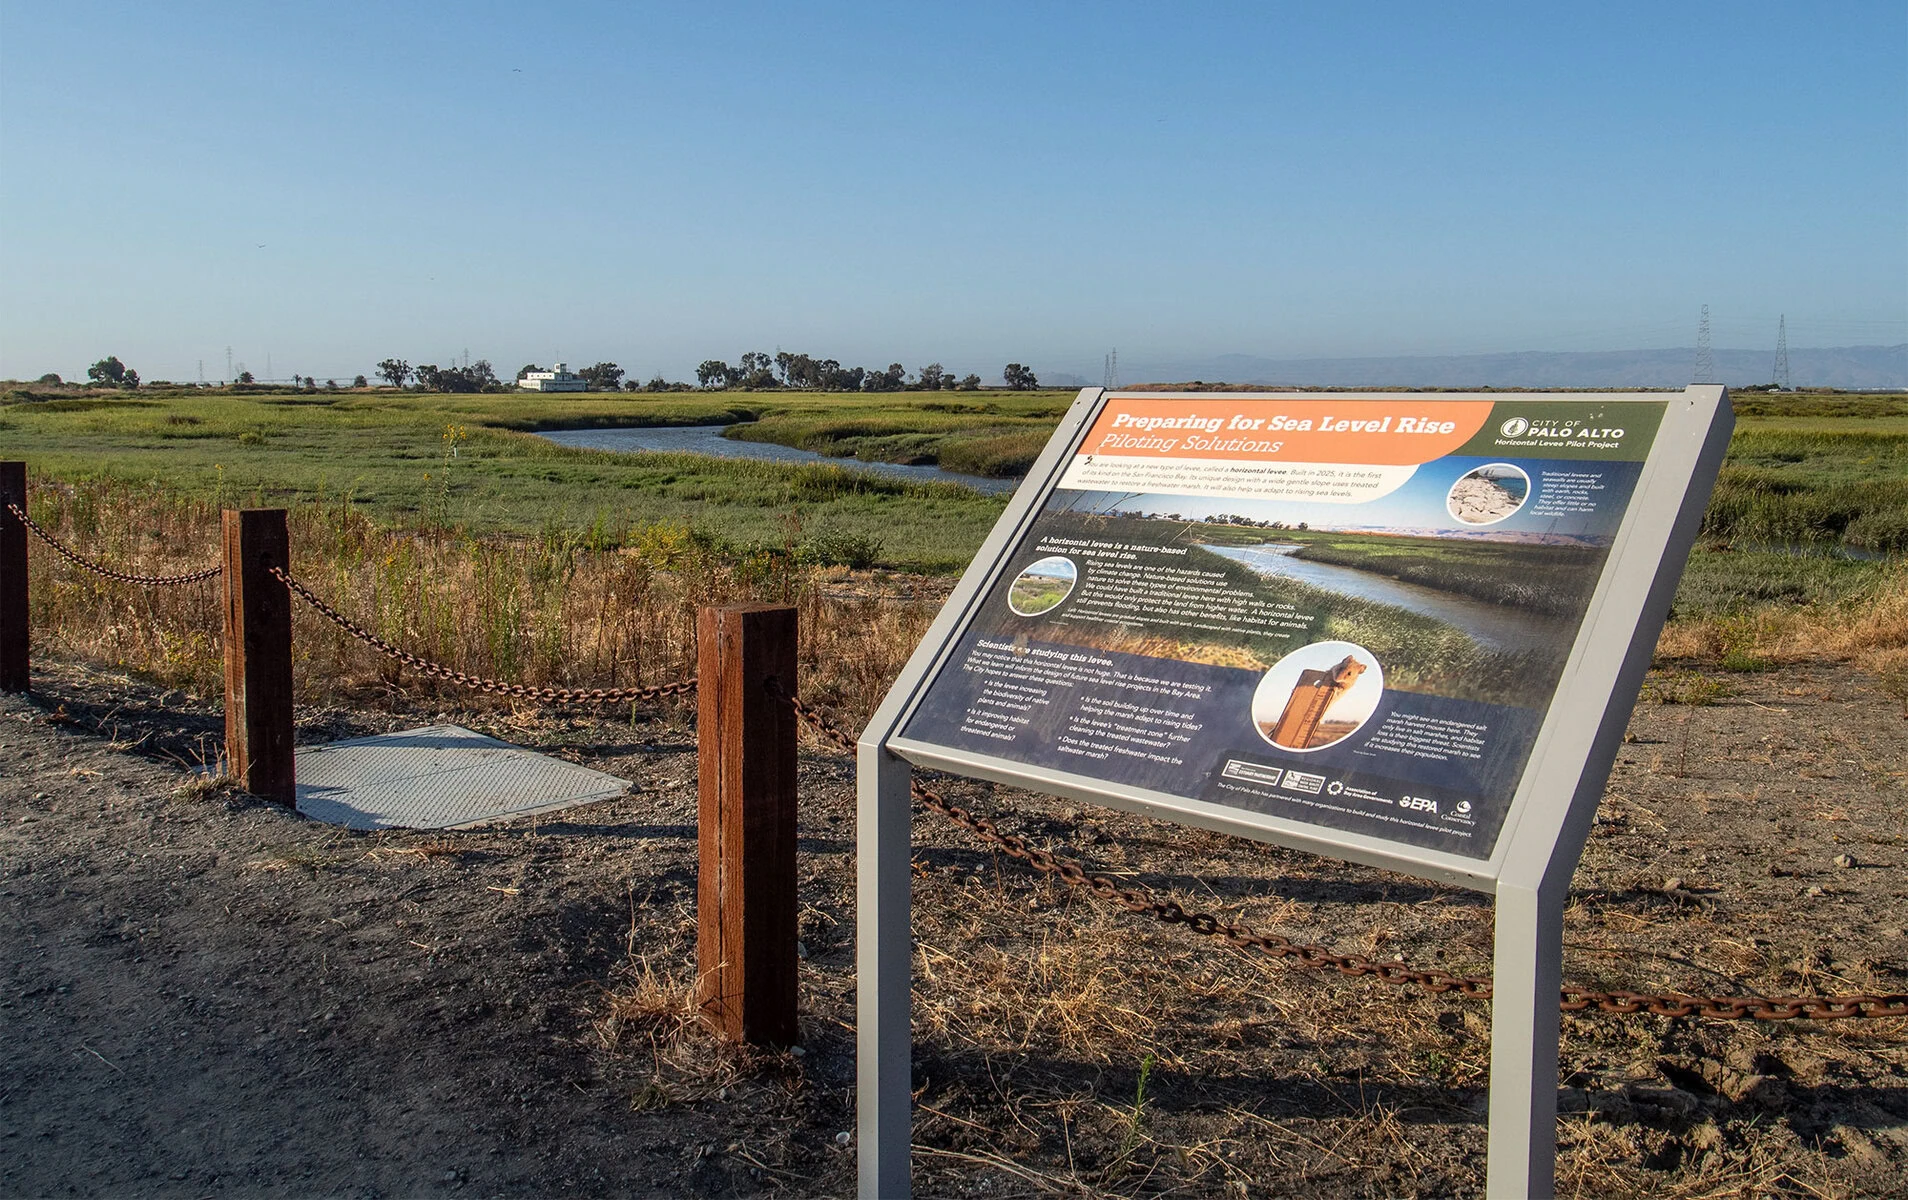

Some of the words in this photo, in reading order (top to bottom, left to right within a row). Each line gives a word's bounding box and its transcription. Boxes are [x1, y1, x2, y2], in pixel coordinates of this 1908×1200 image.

[1111, 413, 1222, 432] Preparing
[1225, 414, 1265, 429] for
[1268, 415, 1312, 430] Sea
[1317, 416, 1393, 432] Level
[1393, 417, 1453, 433] Rise
[1527, 427, 1571, 436] PALO
[1577, 428, 1623, 437] ALTO
[1100, 433, 1177, 453] Piloting
[1181, 435, 1282, 452] Solutions
[1587, 441, 1619, 449] Project
[1035, 545, 1068, 553] solution
[1096, 549, 1119, 557] level
[1048, 537, 1091, 546] horizontal
[1089, 540, 1113, 548] levee
[1129, 545, 1187, 554] nature-based
[1085, 559, 1103, 567] Rising
[1118, 570, 1141, 578] change.
[1142, 572, 1186, 582] Nature-based
[1185, 577, 1214, 585] solutions
[1148, 589, 1182, 597] traditional
[1231, 597, 1247, 606] high
[1113, 601, 1140, 611] flooding,
[1199, 611, 1227, 620] benefits,
[1241, 616, 1267, 624] habitat
[1279, 621, 1307, 629] animals.
[1204, 603, 1227, 611] higher
[1258, 609, 1295, 618] horizontal
[977, 639, 1016, 651] Scientists
[1031, 648, 1068, 661] studying
[1068, 653, 1086, 661] this
[1086, 655, 1113, 666] levee.
[1113, 701, 1138, 712] building
[1079, 704, 1103, 715] helping
[1134, 715, 1154, 723] adapt
[1162, 719, 1180, 728] rising
[1180, 722, 1202, 730] tides?
[1439, 719, 1476, 728] endangered
[1068, 724, 1094, 736] cleaning
[1105, 731, 1130, 741] treated
[1129, 737, 1171, 748] wastewater?
[1167, 732, 1190, 742] further
[1057, 745, 1085, 755] saltwater
[1084, 751, 1109, 759] marsh?
[1061, 736, 1078, 744] Does
[1089, 742, 1114, 751] treated
[1112, 746, 1147, 757] freshwater
[1146, 753, 1171, 762] impact
[1409, 797, 1436, 813] EPA
[1440, 814, 1475, 826] Conservancy
[1450, 810, 1471, 818] Coastal
